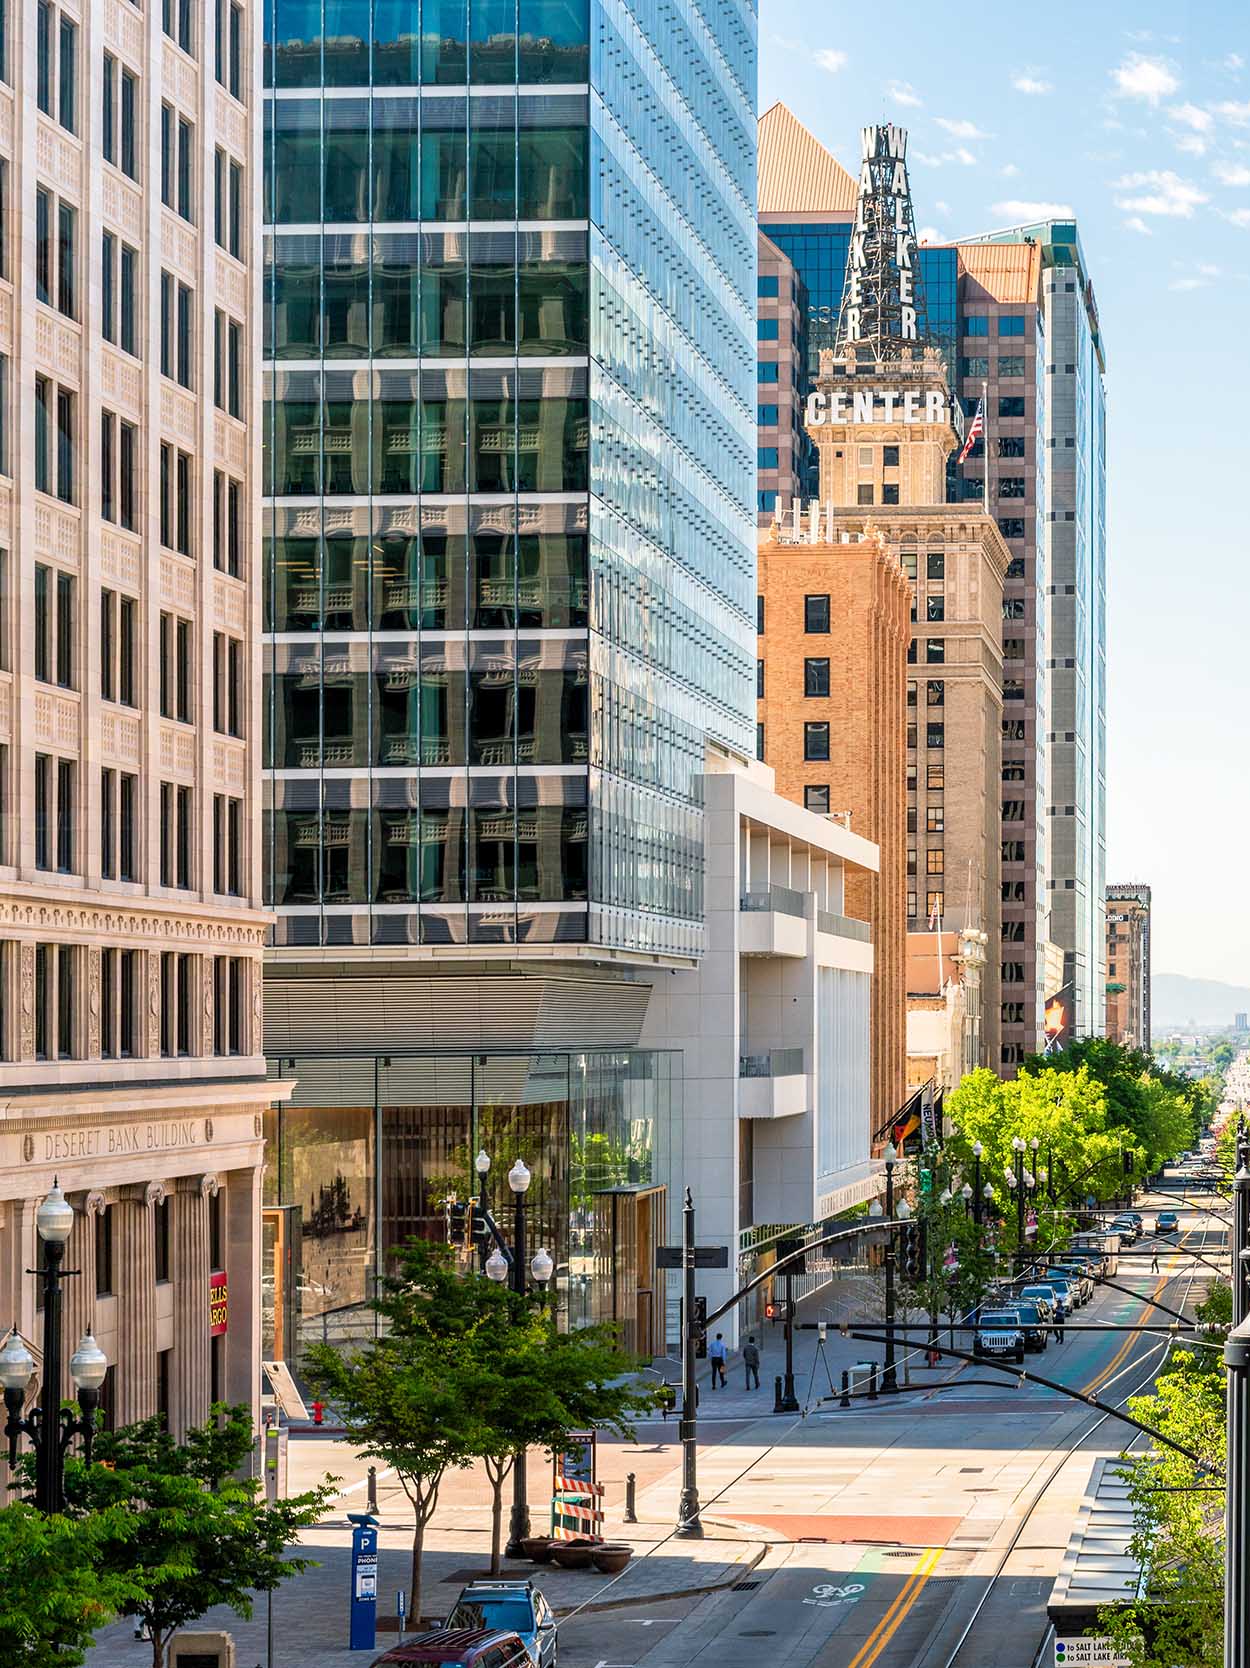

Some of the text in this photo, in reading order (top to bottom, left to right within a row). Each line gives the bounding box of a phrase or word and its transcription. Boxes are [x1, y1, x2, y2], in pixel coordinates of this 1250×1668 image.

[847, 127, 878, 340] WALKER
[888, 127, 918, 340] WALKER
[807, 391, 945, 426] CENTER
[45, 1121, 197, 1160] DESERET BANK BUILDING
[210, 1285, 227, 1305] ELLS
[210, 1307, 227, 1327] RGO
[360, 1538, 370, 1550] P
[1076, 1643, 1091, 1651] SALT
[1076, 1653, 1091, 1661] SALT
[1093, 1653, 1110, 1661] LAKE
